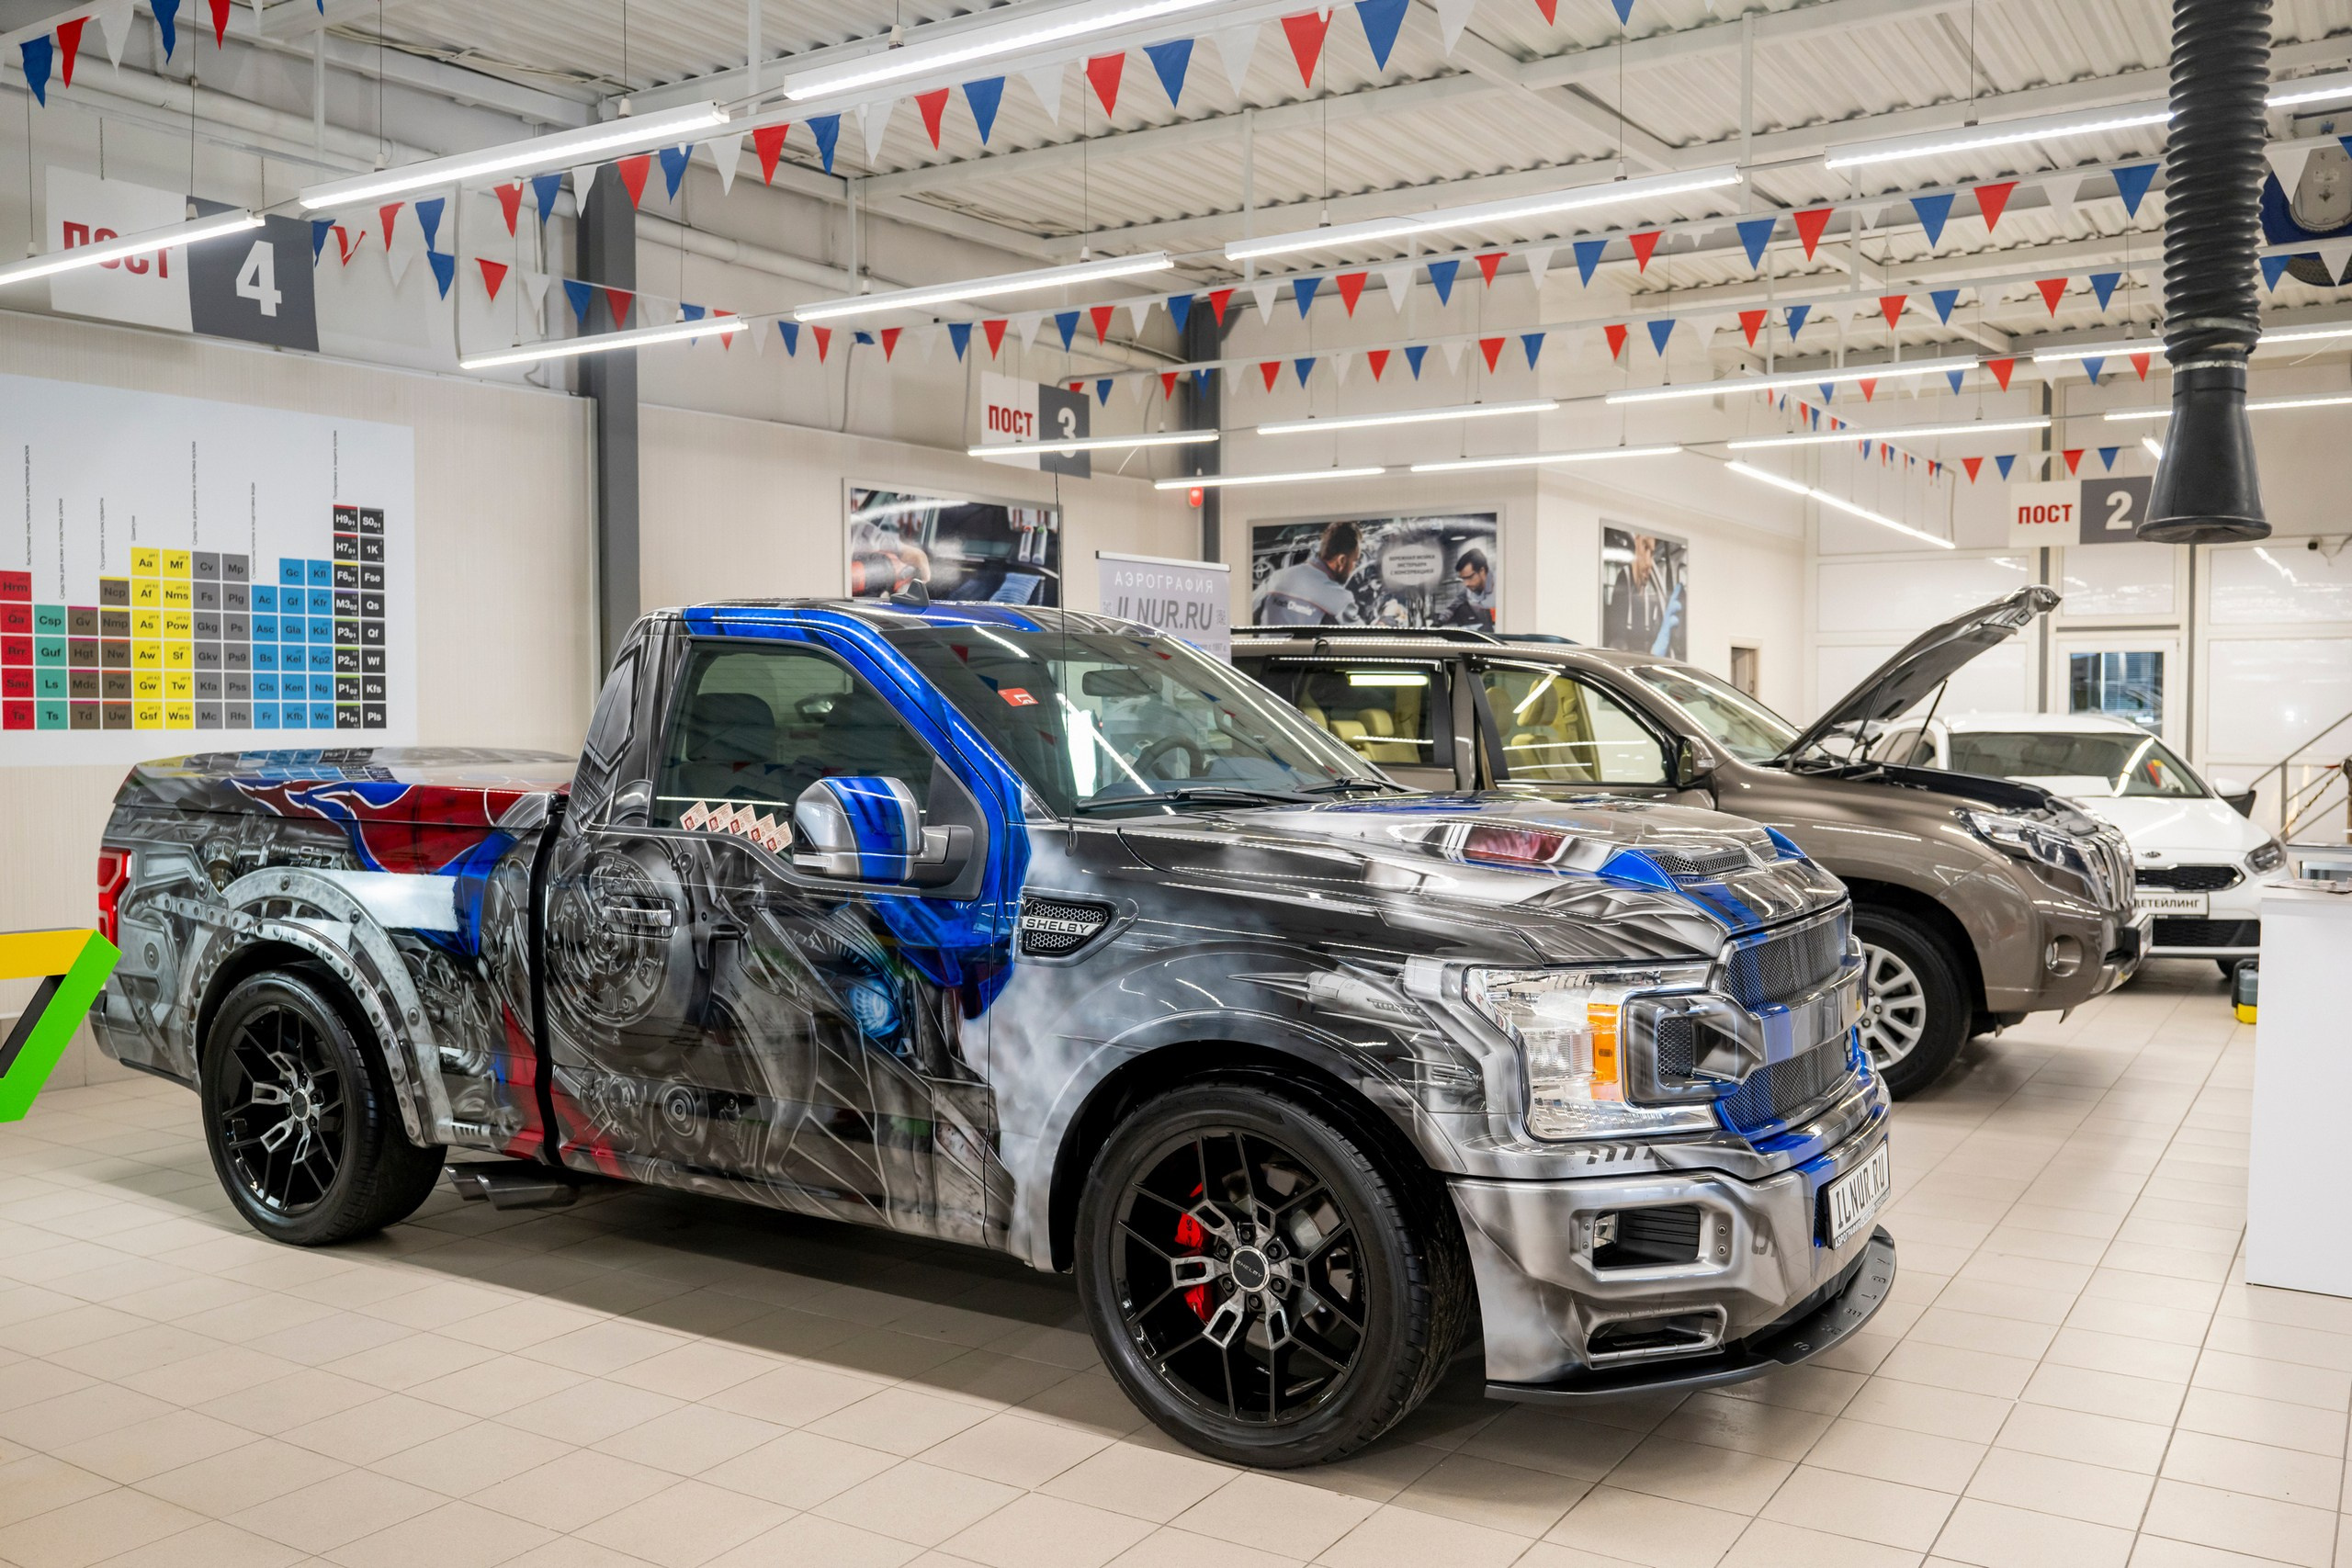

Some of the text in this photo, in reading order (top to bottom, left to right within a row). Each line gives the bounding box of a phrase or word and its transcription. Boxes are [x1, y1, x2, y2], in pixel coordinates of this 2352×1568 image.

[236, 240, 282, 317] 4
[989, 404, 1076, 458] ПОСТ 3
[2018, 491, 2133, 530] ПОСТ 2
[367, 546, 379, 554] 1K
[139, 558, 152, 567] Aa
[200, 562, 212, 570] Cv
[229, 564, 243, 574] Mp
[1114, 570, 1214, 593] АЭРОГРАФИЯ
[105, 588, 125, 598] Ncp
[201, 592, 212, 601] Fs
[259, 595, 270, 604] Ac
[367, 600, 379, 610] Qs
[40, 616, 61, 626] Csp
[76, 617, 90, 626] Gv
[103, 618, 128, 629] Nmp
[198, 623, 217, 633] Gkg
[231, 624, 243, 632] Ps
[256, 625, 274, 633] Asc
[368, 628, 379, 637] Qf
[41, 648, 61, 657] Guf
[74, 649, 93, 659] Hgt
[107, 649, 124, 658] Nw
[198, 652, 217, 660] Gkv
[312, 656, 330, 664] Kp2
[368, 657, 380, 666] Wf
[45, 680, 58, 688] Ls
[108, 681, 125, 689] Pw
[140, 682, 156, 690] Gw
[172, 682, 186, 690] Tw
[315, 684, 327, 693] Ng
[367, 684, 382, 694] Kfs
[47, 712, 58, 720] Ts
[78, 712, 92, 720] Td
[109, 712, 126, 720] Uw
[141, 712, 157, 720] Gsf
[202, 712, 216, 720] Mc
[263, 712, 271, 720] Fr
[1026, 919, 1089, 934] SHELBY
[1836, 1152, 1885, 1230] ILNUR.RU
[1235, 1259, 1263, 1278] SHELBY
